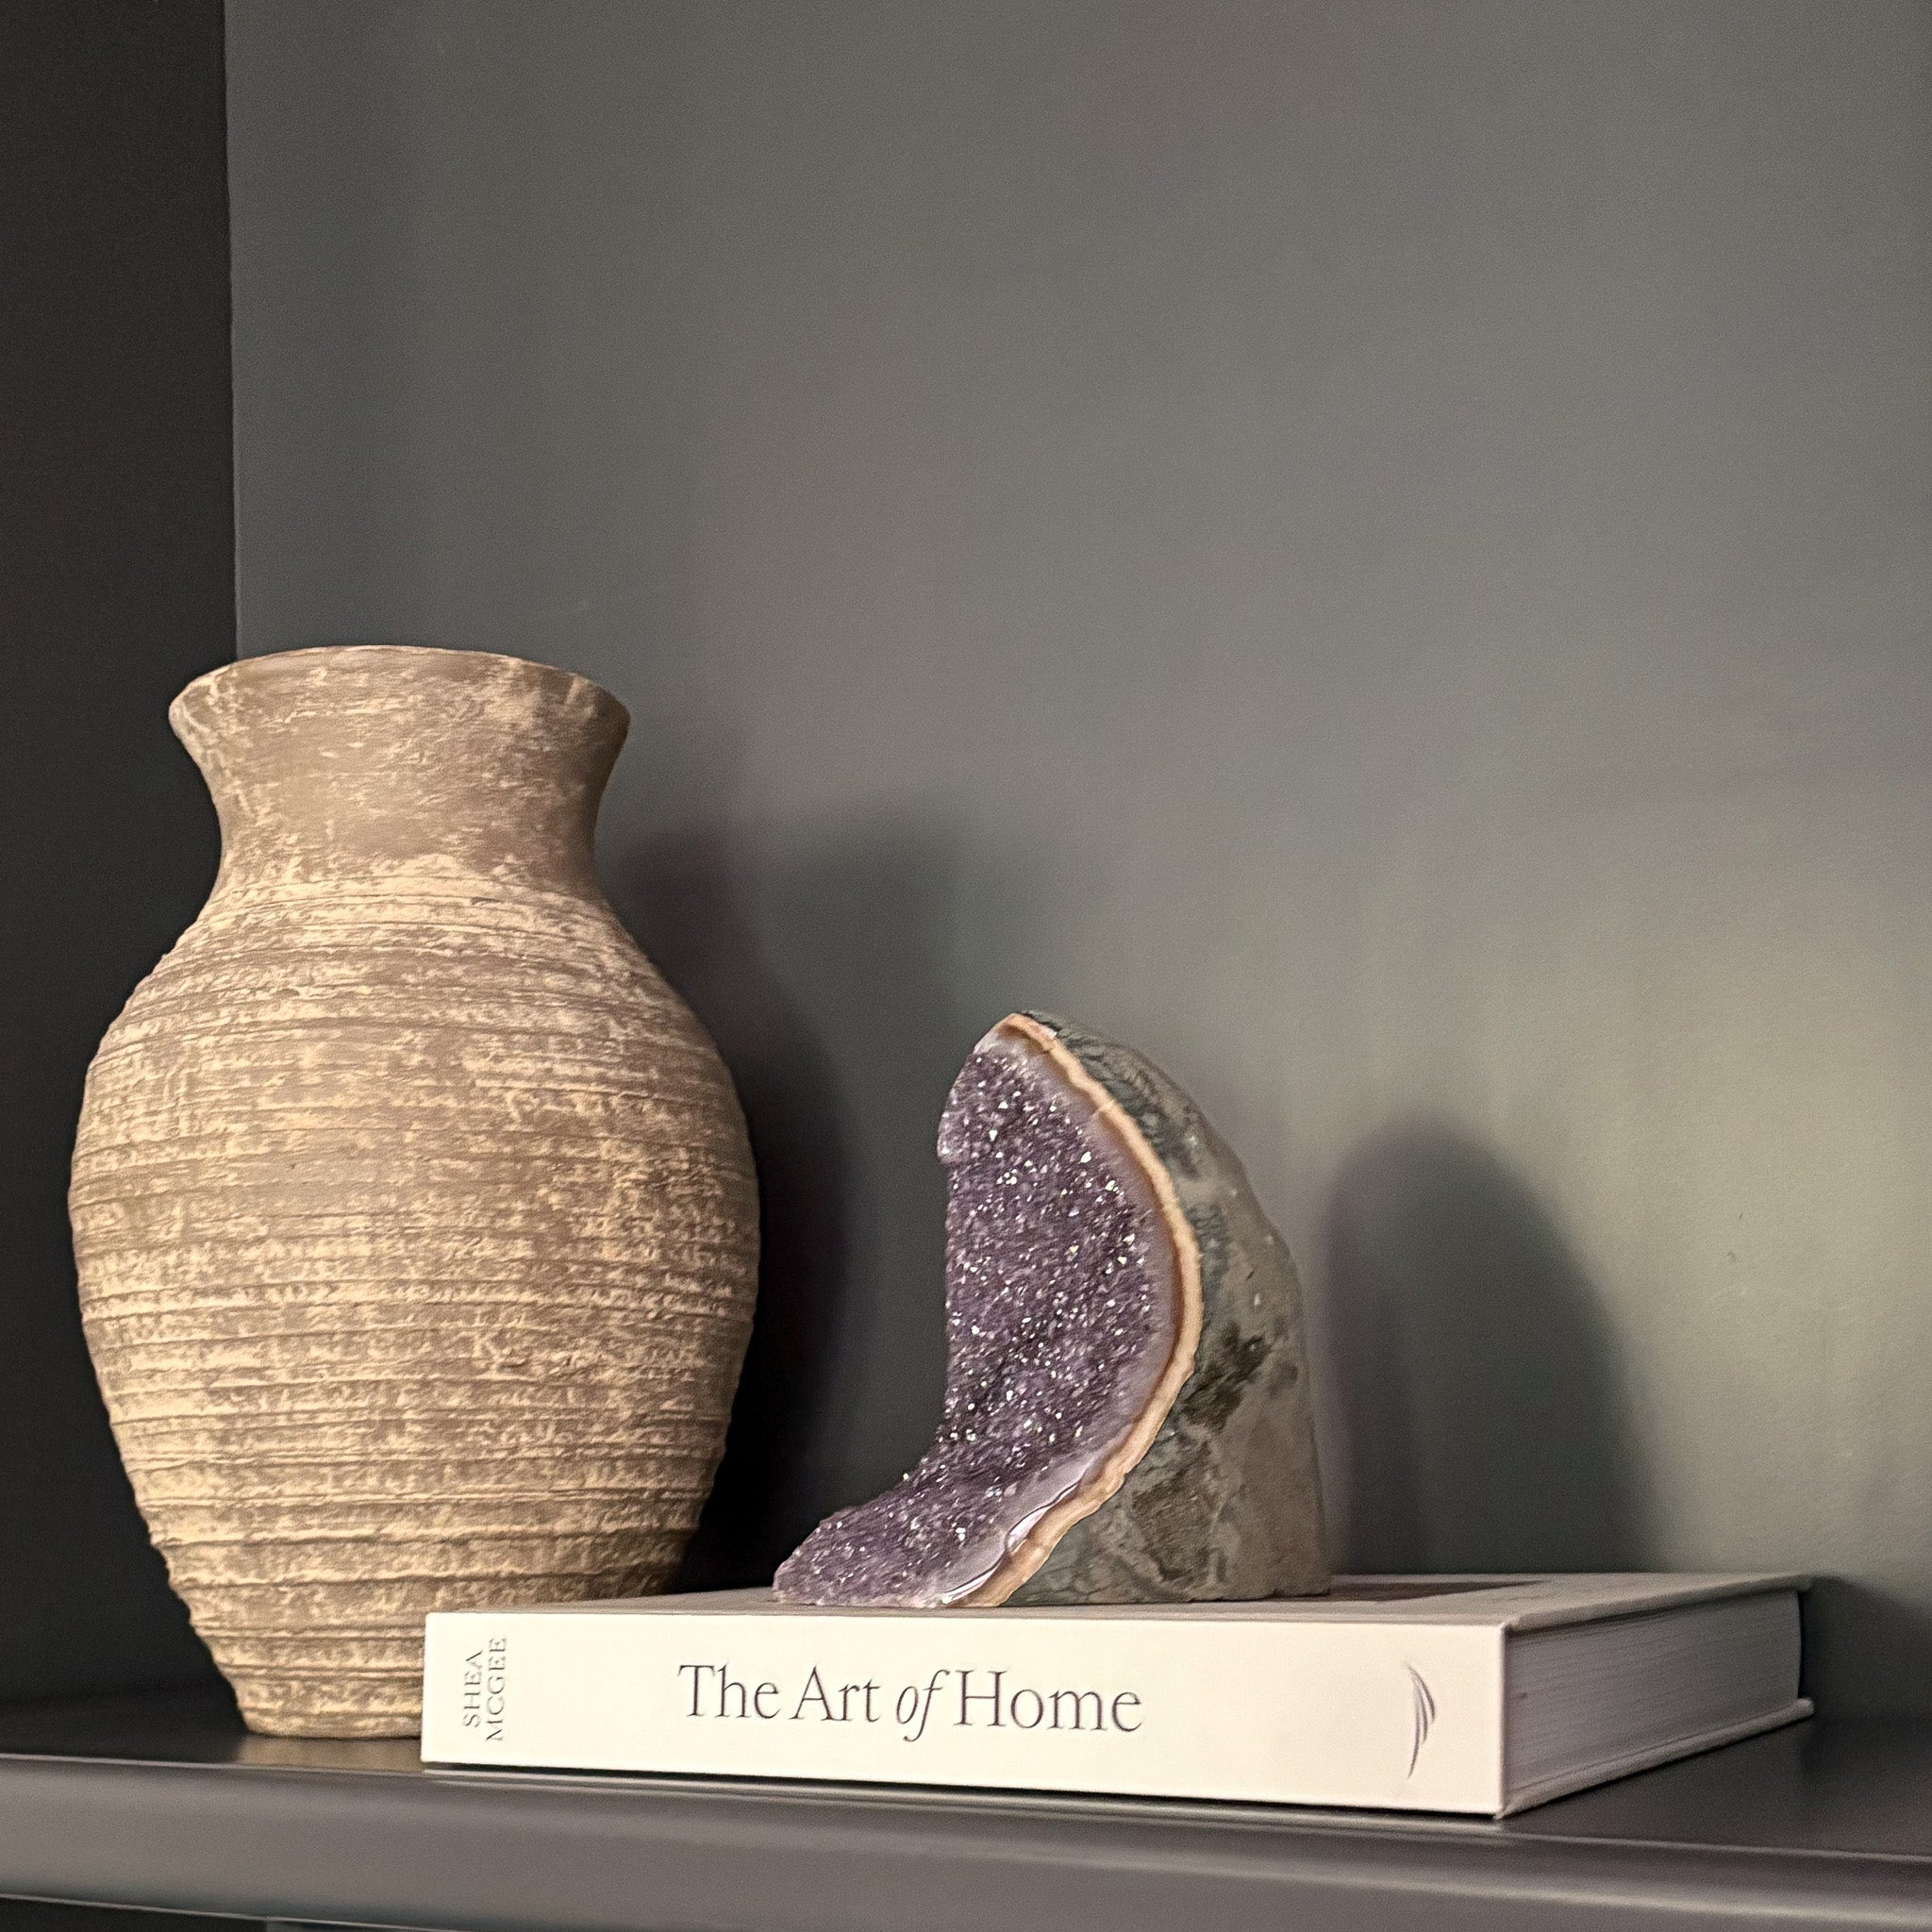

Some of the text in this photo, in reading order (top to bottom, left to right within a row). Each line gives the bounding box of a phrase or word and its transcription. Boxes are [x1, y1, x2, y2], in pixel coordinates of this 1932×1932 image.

[462, 1649, 483, 1727] SHEA
[485, 1637, 507, 1741] MCGEE
[677, 1661, 1143, 1742] The Art of Home
